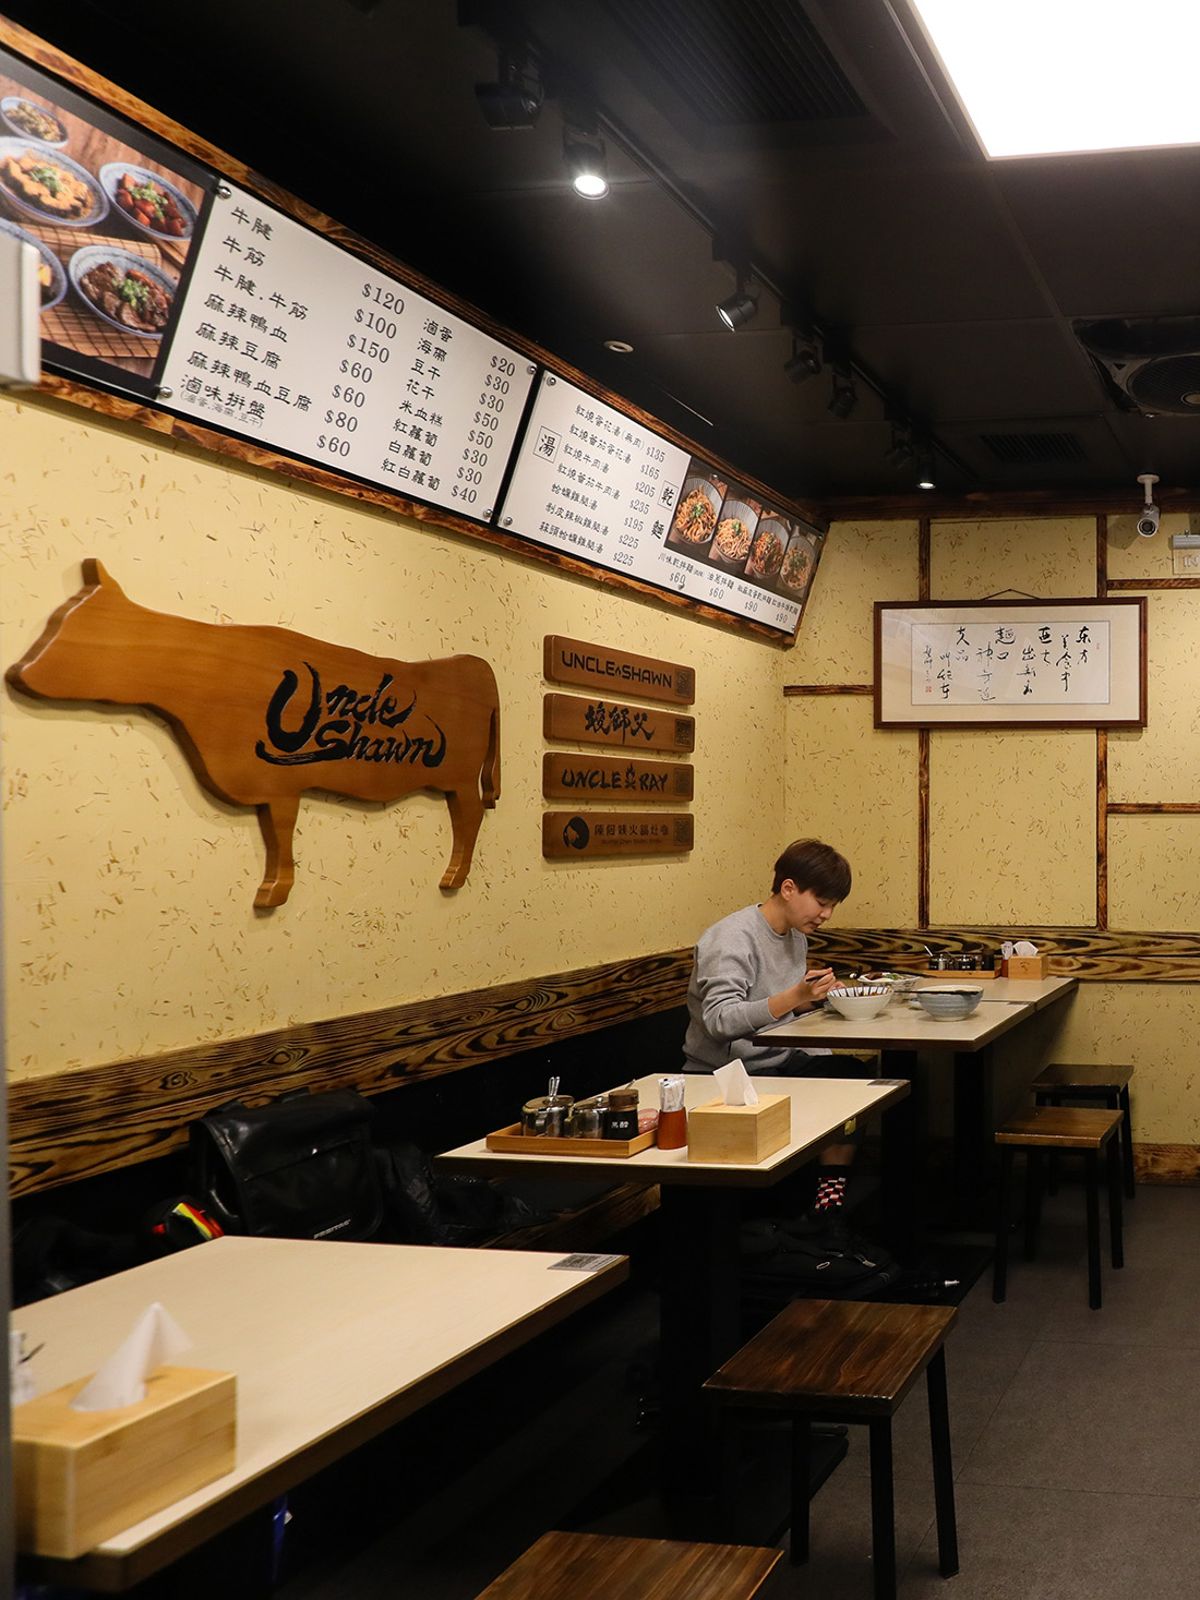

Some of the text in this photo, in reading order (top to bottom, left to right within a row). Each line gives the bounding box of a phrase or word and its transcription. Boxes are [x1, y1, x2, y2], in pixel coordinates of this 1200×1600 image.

[231, 207, 405, 315] 牛腱 $120
[223, 236, 397, 338] 牛筋 $100
[205, 294, 372, 382] 麻辣鴨血 $60
[347, 334, 390, 363] $150
[423, 319, 516, 376] 滷蛋 $20
[196, 322, 366, 408] 麻辣豆腐 $60
[485, 374, 509, 394] $30
[188, 351, 358, 432] 麻辣鴨血豆腐 $80
[411, 359, 504, 412] 豆干 $30
[399, 400, 493, 448] 米血糕 $50
[406, 379, 499, 431] 花干 $50
[317, 434, 351, 457] $60
[393, 418, 488, 467] 紅蘿蔔 $30
[539, 434, 555, 457] 湯
[646, 446, 665, 463] $135
[381, 458, 477, 503] 紅白蘿蔔 $40
[389, 440, 482, 485] 白蘿蔔 $30
[563, 443, 655, 498] 紅燒牛肉湯 $205
[640, 464, 659, 480] $165
[624, 517, 644, 532] $195
[630, 499, 650, 515] $235
[613, 552, 634, 566] $225
[619, 534, 639, 549] $225
[670, 572, 686, 584] $60
[709, 588, 724, 599] $60
[745, 601, 758, 612] $90
[776, 613, 788, 623] $90
[561, 650, 672, 688] UNCLE SHAWN
[266, 661, 417, 752] Uncle
[255, 715, 446, 767] Shawn
[561, 768, 668, 792] UNCLE RAY
